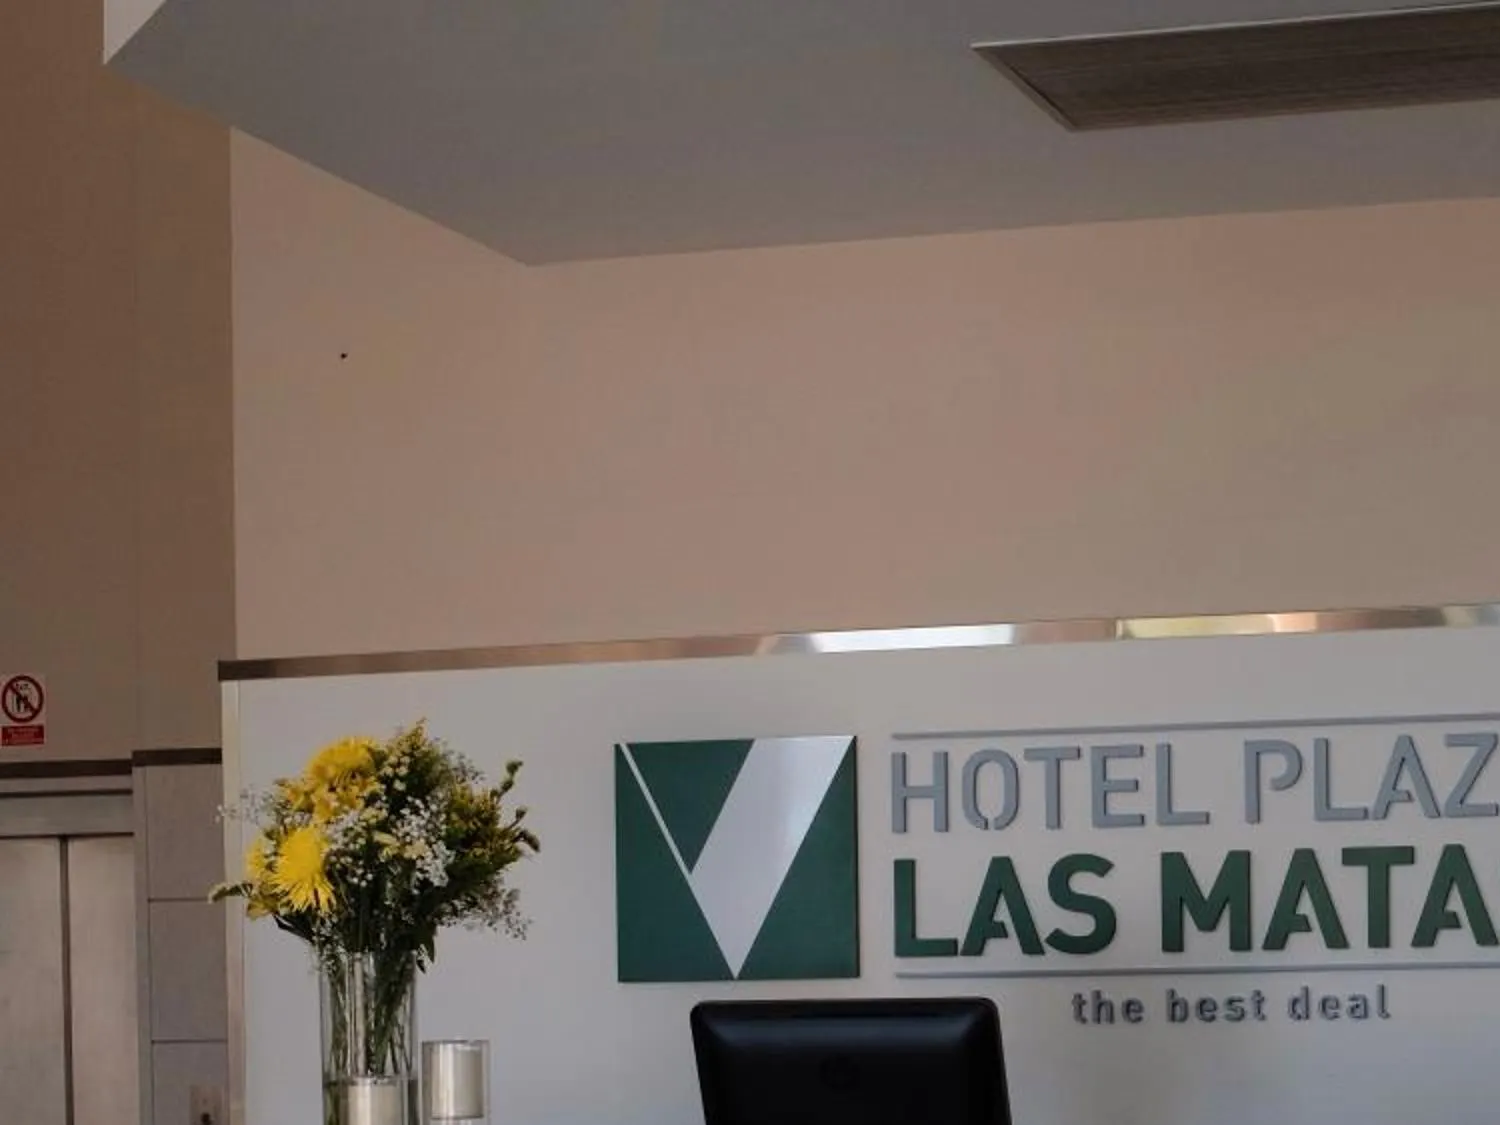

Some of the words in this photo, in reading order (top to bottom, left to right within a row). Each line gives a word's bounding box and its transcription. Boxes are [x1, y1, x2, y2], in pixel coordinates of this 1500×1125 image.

[890, 743, 1211, 833] HOTEL
[893, 852, 1118, 958] LAS
[1071, 988, 1146, 1025] the
[1165, 987, 1268, 1024] best
[1287, 983, 1392, 1021] deal
